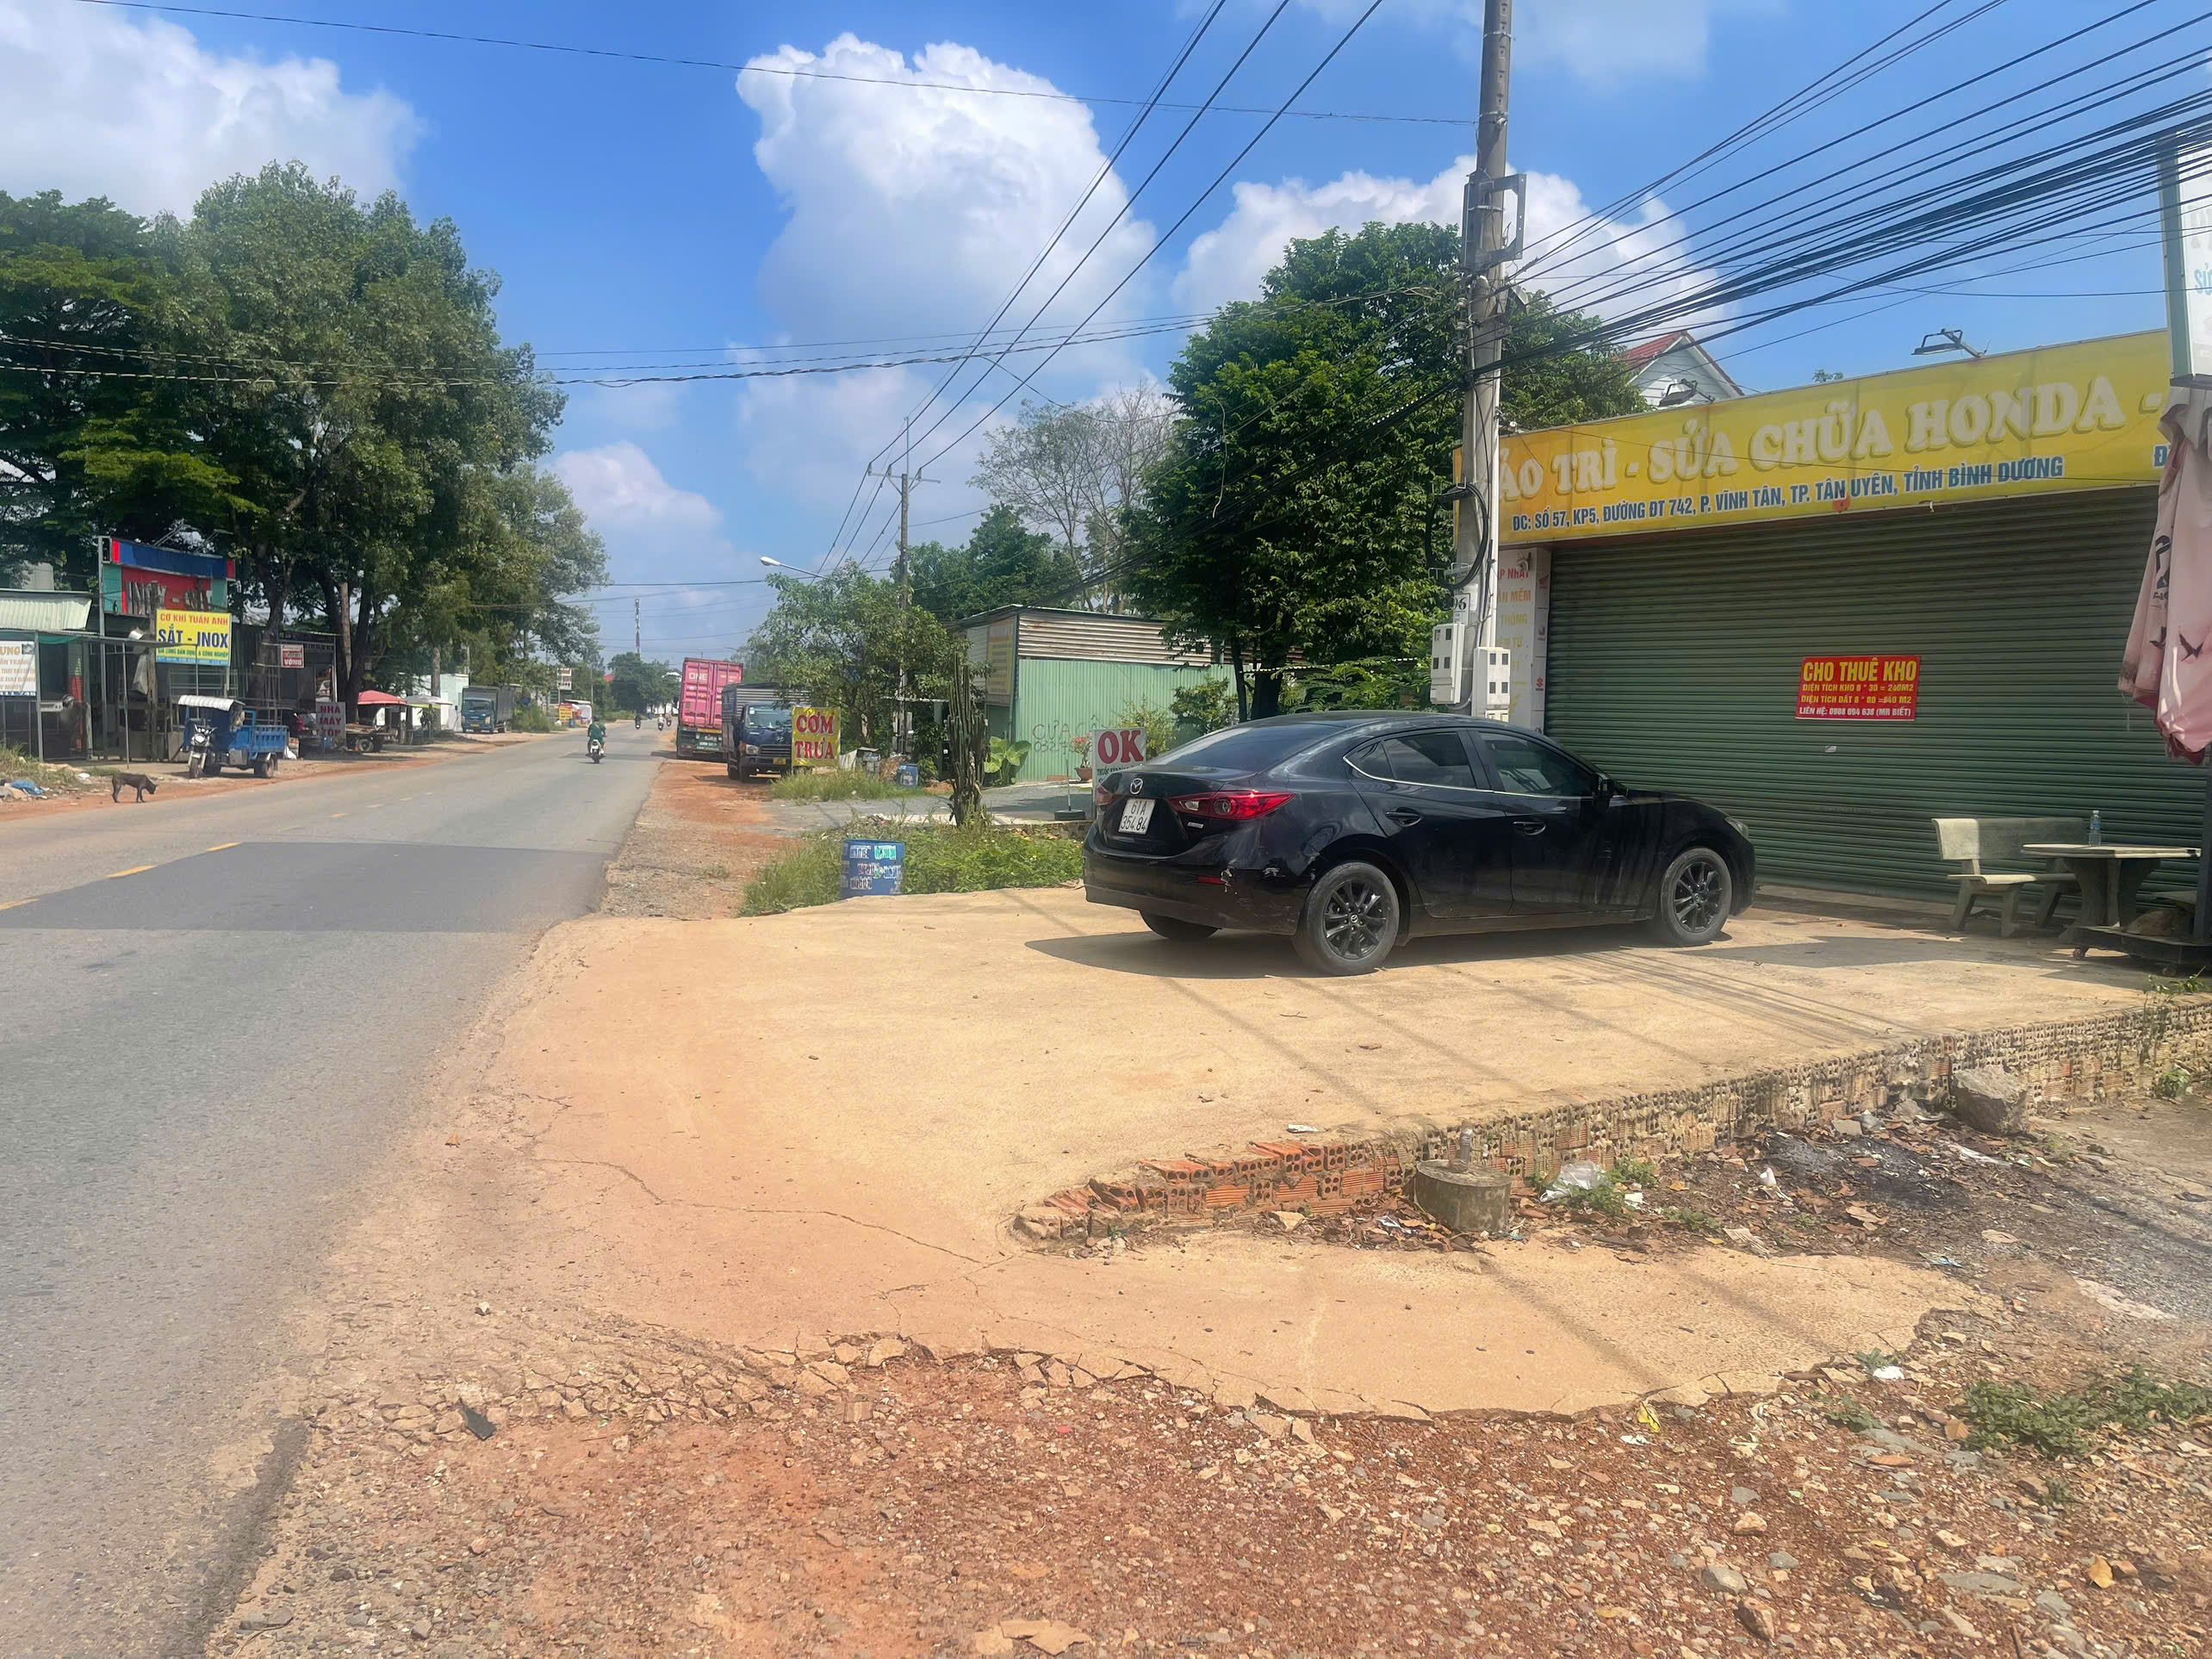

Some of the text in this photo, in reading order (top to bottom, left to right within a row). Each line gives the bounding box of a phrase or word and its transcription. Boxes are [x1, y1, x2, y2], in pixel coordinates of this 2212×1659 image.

[1499, 447, 1544, 501] ẢO
[1648, 419, 1737, 484] SỬA
[1749, 400, 1894, 472] CHỮA
[1904, 376, 2127, 454] HONDA
[1513, 444, 2171, 531] ĐC: SỐ 57, KP5, ĐƯỜNG ĐT 742, P. VĨNH TÂN, TP. TÂN UYÊN, TỈNH BÌNH DƯƠNG Đ
[212, 616, 228, 626] ANH
[196, 631, 228, 649] INOX
[1803, 656, 1917, 682] CHO THUÊ KHO
[1802, 683, 1820, 693] DIỆN
[1822, 683, 1837, 692] TÍCH
[1801, 695, 1819, 705] DIỆN
[1821, 695, 1836, 704] TÍCH
[1799, 706, 1815, 715] LIÊN
[1817, 706, 1828, 717] HỆ:
[1876, 708, 1890, 717] (MR
[1892, 706, 1911, 717] BIẾT)
[796, 711, 835, 735] CƠM
[794, 737, 835, 760] TRƯA
[1097, 730, 1144, 765] OK
[1131, 800, 1147, 815] 61A
[1121, 815, 1146, 832] 354.84
